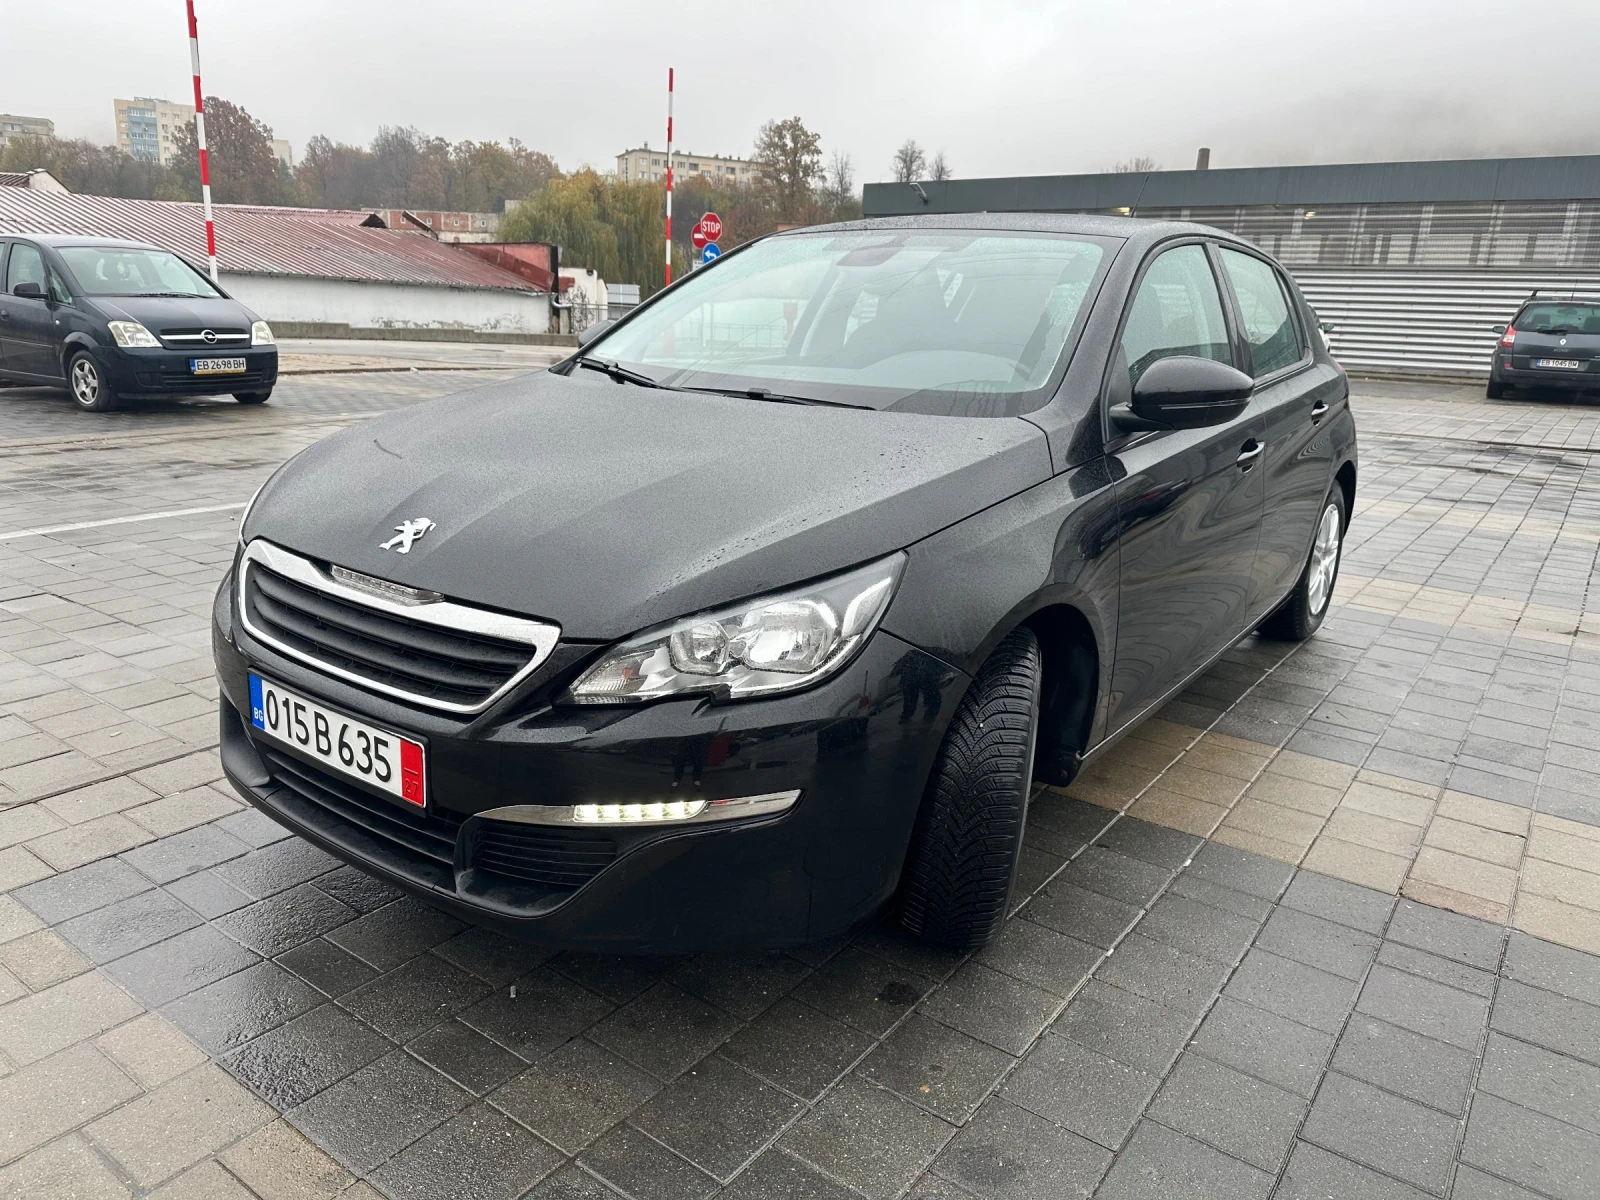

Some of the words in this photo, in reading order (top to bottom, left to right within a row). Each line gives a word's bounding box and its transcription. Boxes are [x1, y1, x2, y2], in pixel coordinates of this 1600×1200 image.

[702, 221, 720, 233] STOP
[196, 360, 210, 371] EB
[210, 360, 233, 370] 2698
[233, 359, 245, 369] BH
[341, 569, 411, 597] PEUGEOT
[253, 706, 264, 722] BG
[405, 778, 419, 797] 27
